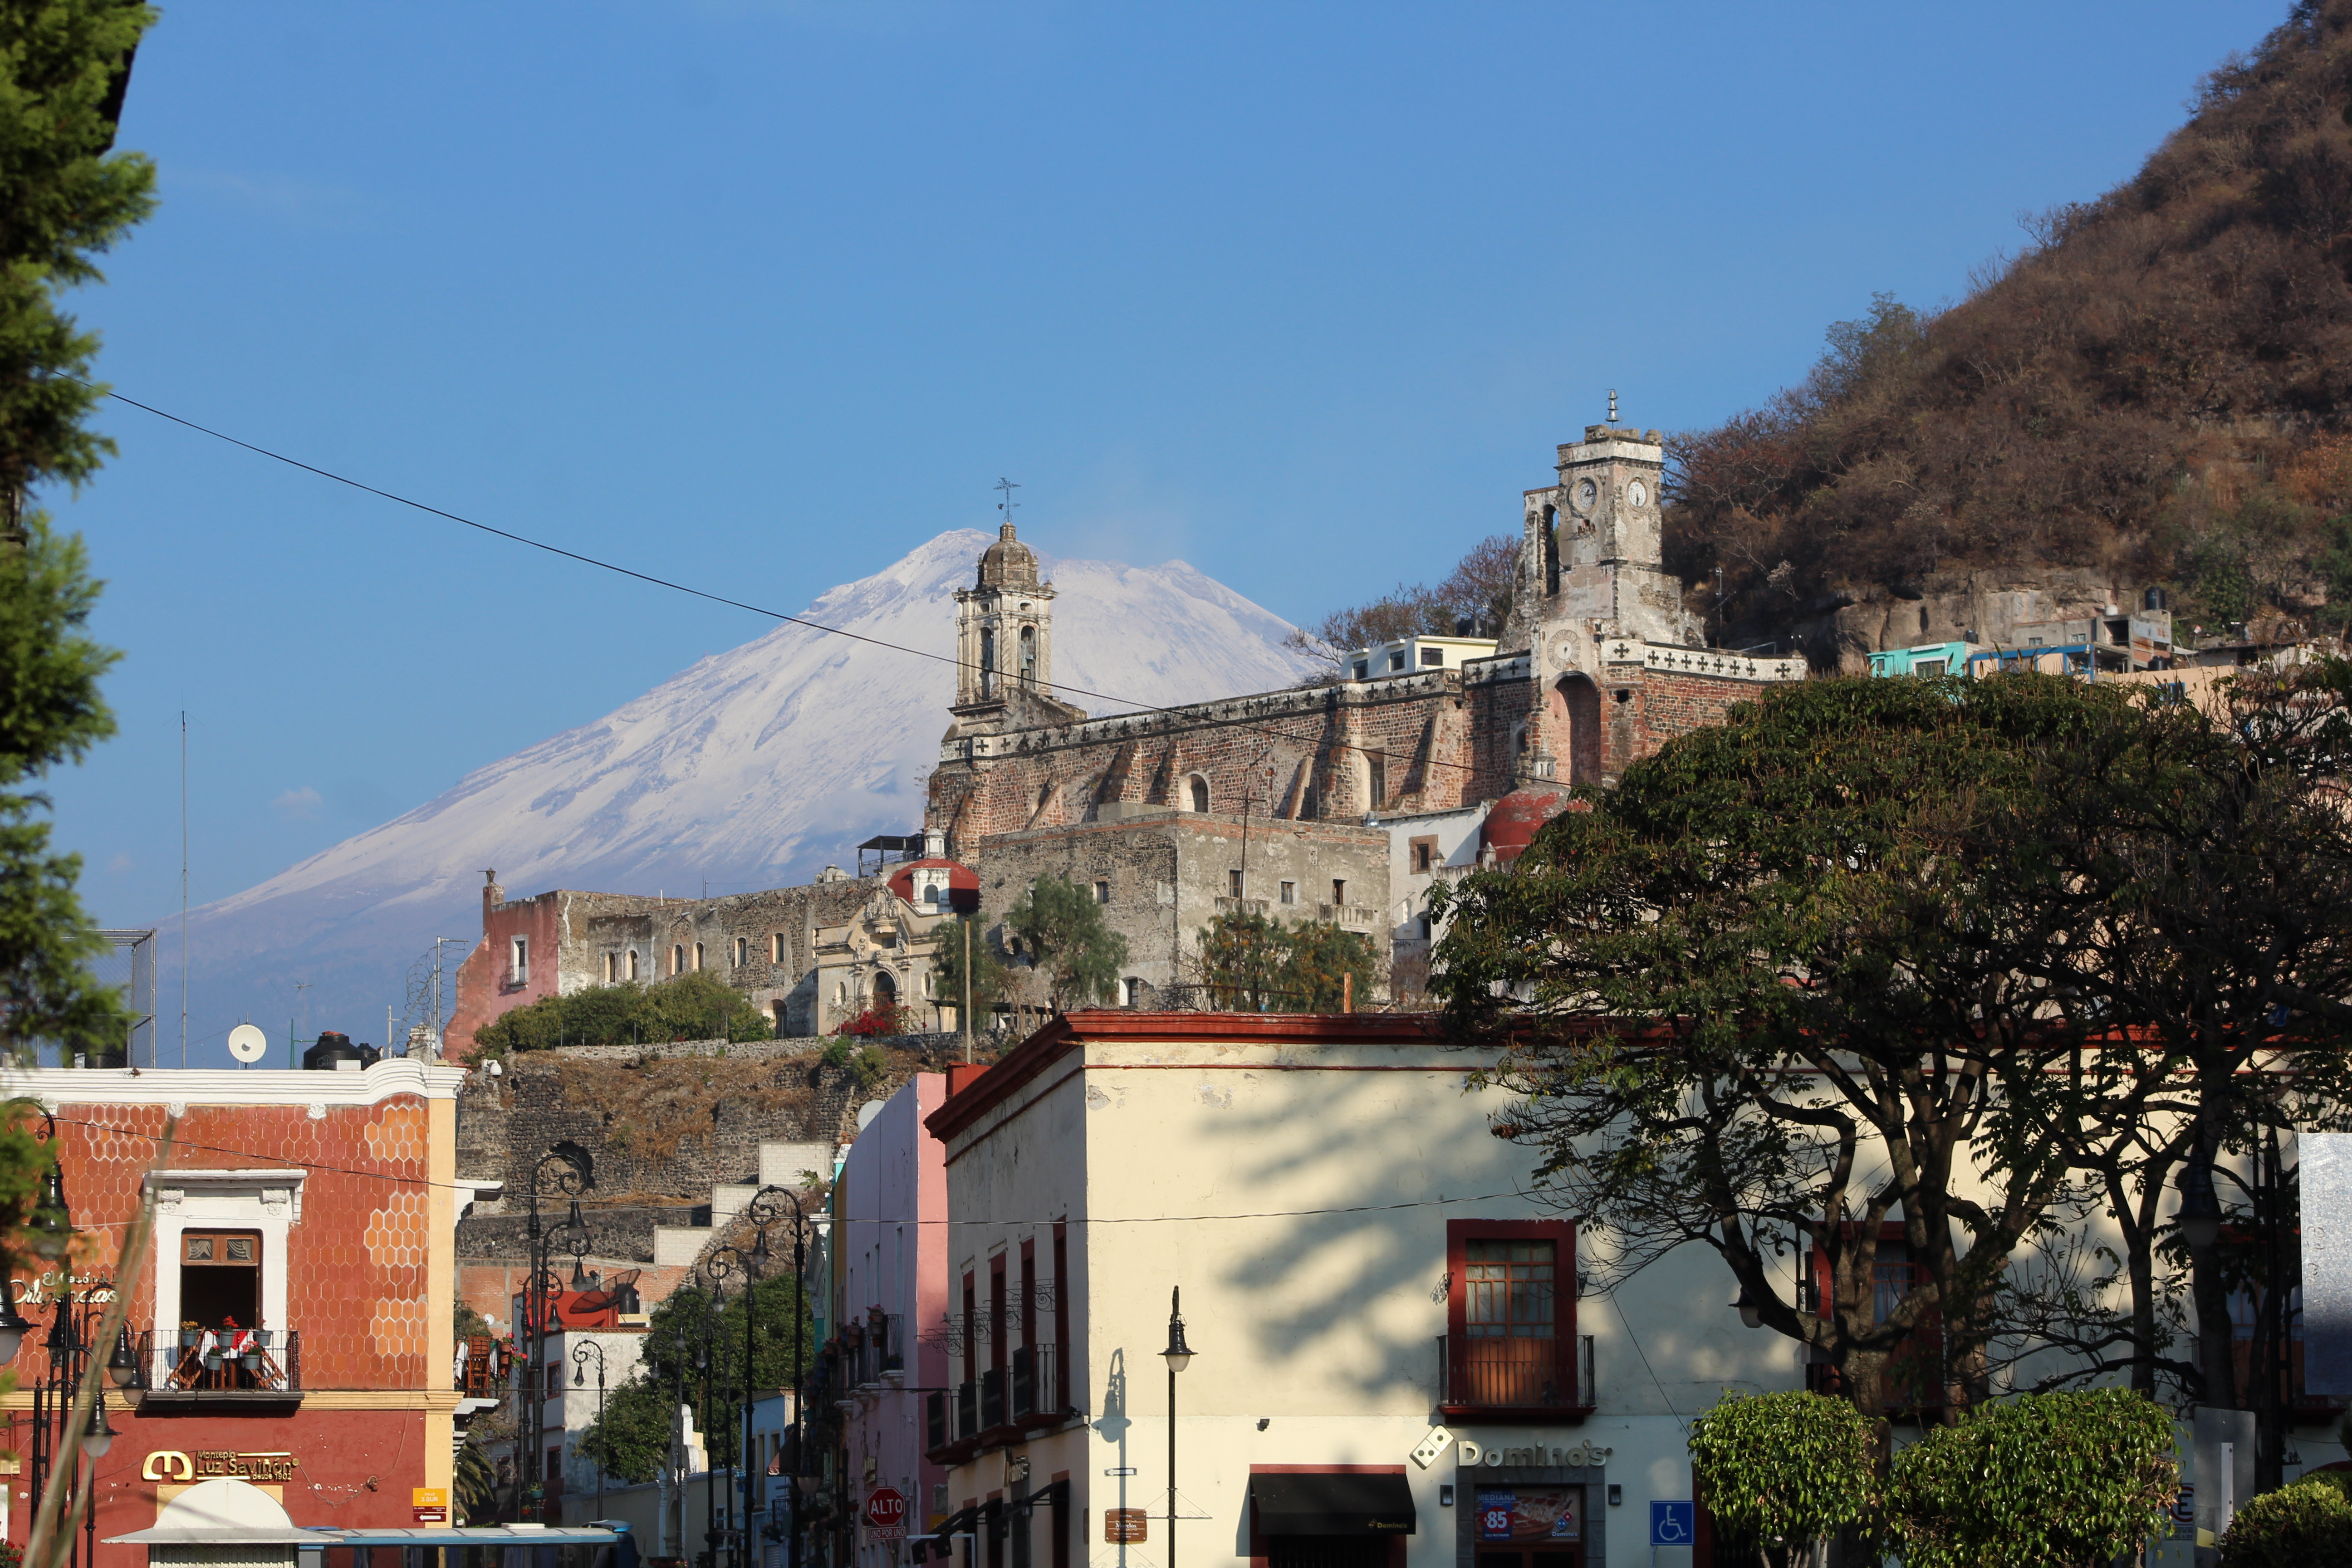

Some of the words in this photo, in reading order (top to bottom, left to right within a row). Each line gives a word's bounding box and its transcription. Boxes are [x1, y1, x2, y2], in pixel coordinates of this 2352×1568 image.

[197, 1458, 224, 1473] Luz
[229, 1457, 292, 1474] Saviñón
[871, 1499, 903, 1514] ALTO
[870, 1529, 881, 1538] UNO
[882, 1529, 893, 1537] POR
[894, 1528, 905, 1537] UNO
